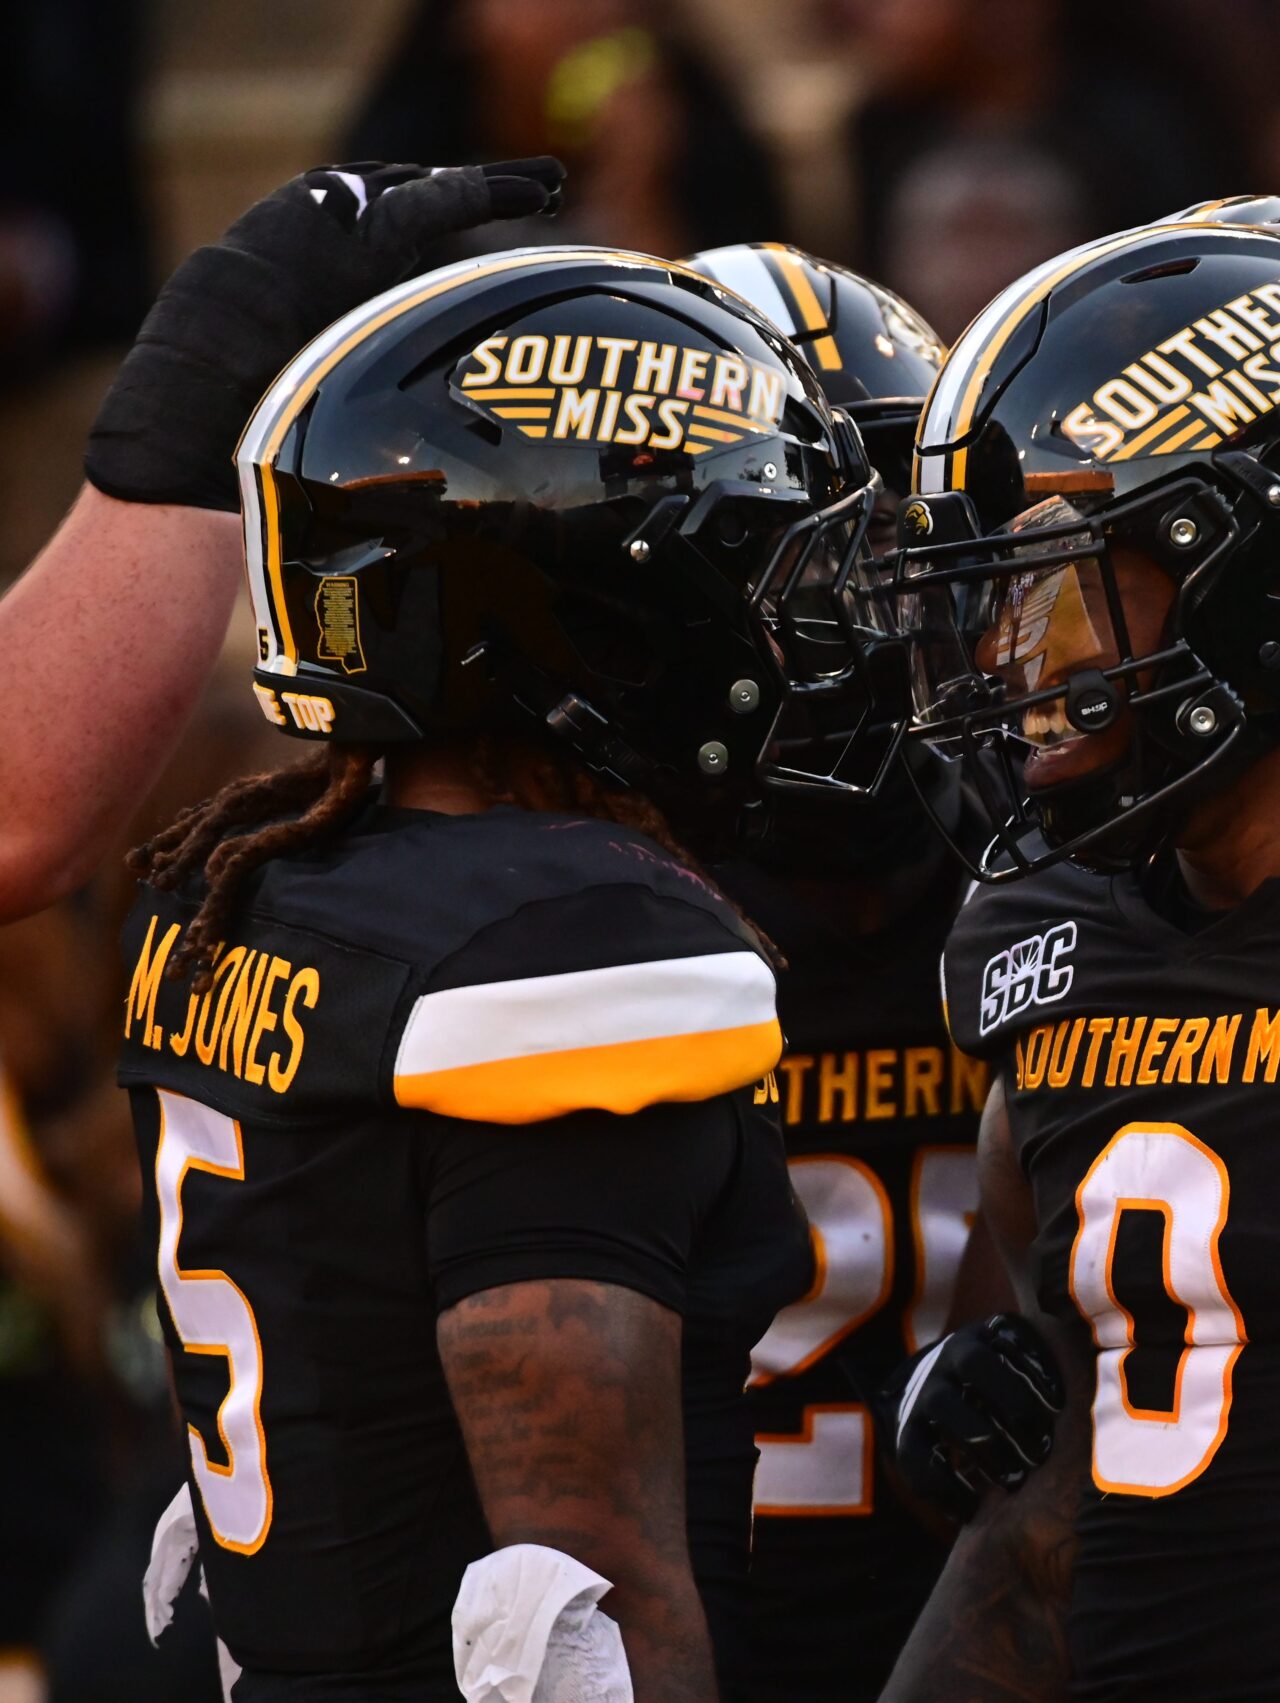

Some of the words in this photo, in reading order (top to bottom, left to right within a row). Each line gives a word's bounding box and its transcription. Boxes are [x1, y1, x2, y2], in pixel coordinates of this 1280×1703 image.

[461, 335, 782, 422] SOUTHERN
[552, 388, 689, 450] MISS
[258, 628, 269, 661] 5
[281, 692, 336, 734] TOP
[124, 915, 181, 1050] M.
[169, 942, 320, 1093] JONES
[980, 920, 1077, 1037] SBC
[780, 1047, 990, 1126] THERN
[155, 1087, 273, 1555] 5
[1068, 1121, 1250, 1498] 0
